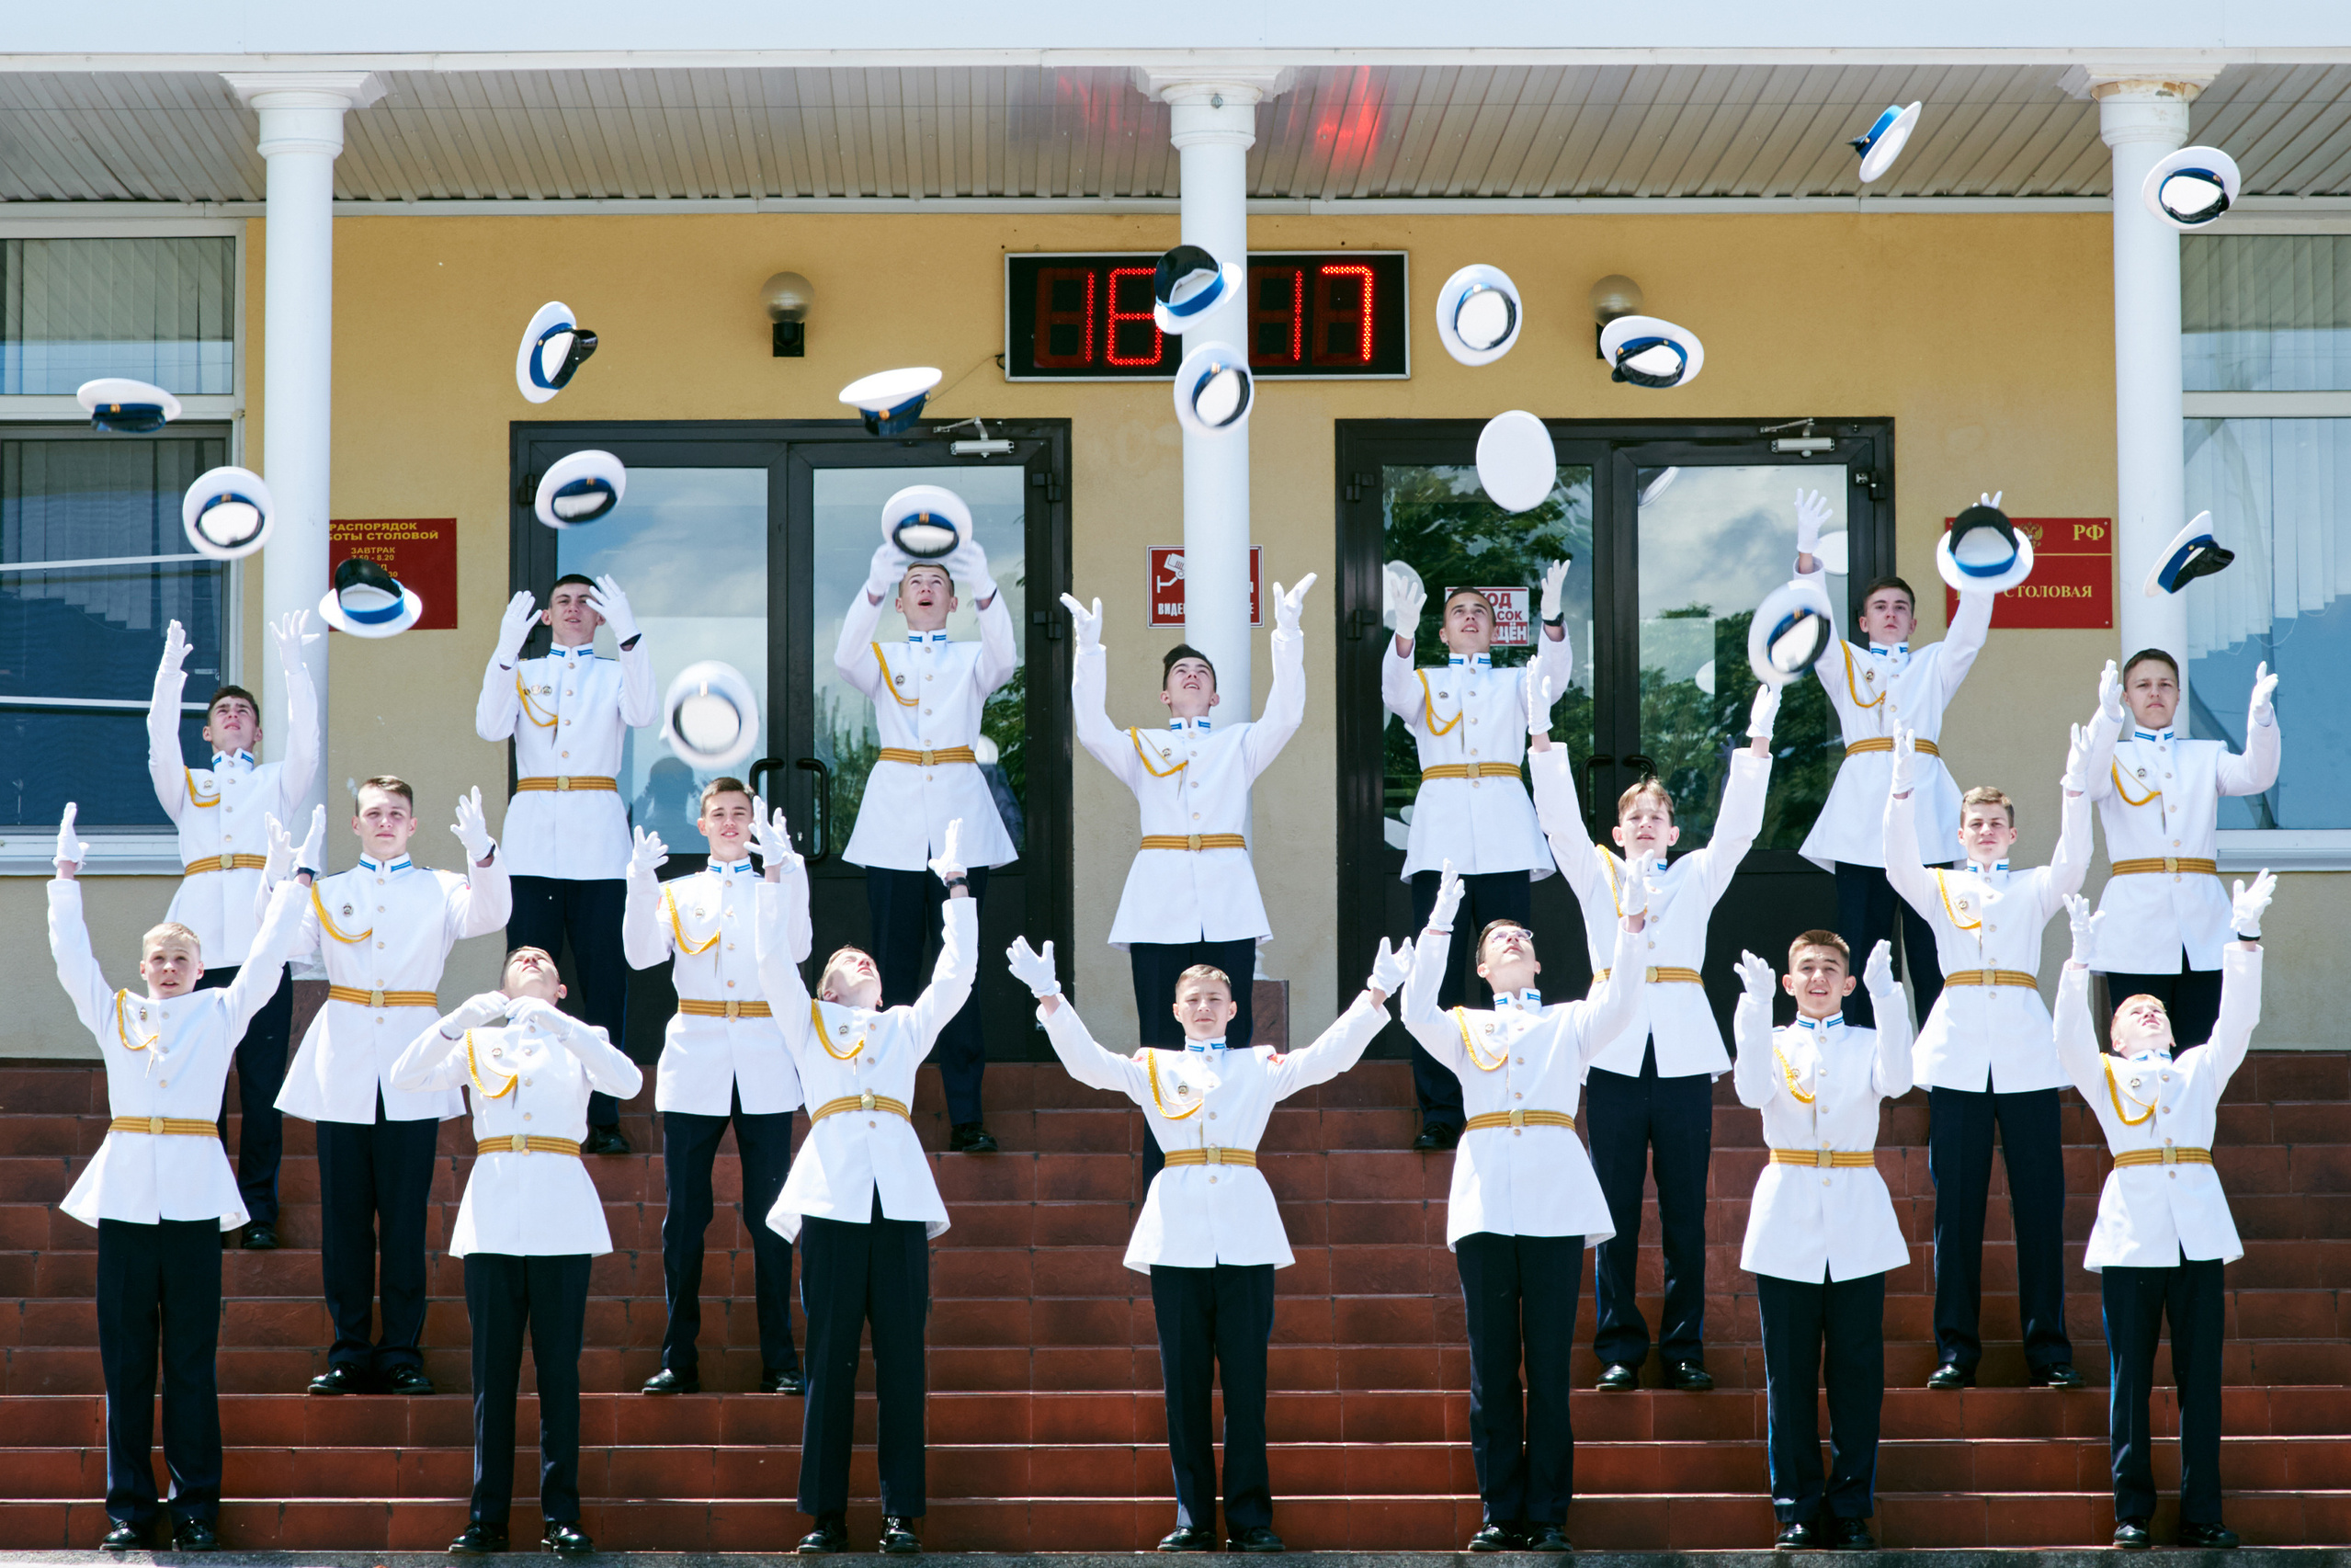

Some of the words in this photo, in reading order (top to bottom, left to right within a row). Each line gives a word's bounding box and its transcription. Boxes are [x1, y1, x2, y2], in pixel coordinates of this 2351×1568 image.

[1294, 265, 1373, 361] 17
[329, 522, 417, 532] РАСПОРЯДОК
[2073, 524, 2105, 541] РФ
[366, 530, 438, 541] СТОЛОВОЙ
[351, 546, 396, 555] ЗАВТРАК
[376, 553, 395, 562] 8.20
[2003, 585, 2093, 598] СТОЛОВАЯ
[1482, 592, 1513, 609] ОД
[1495, 609, 1523, 621] СОК
